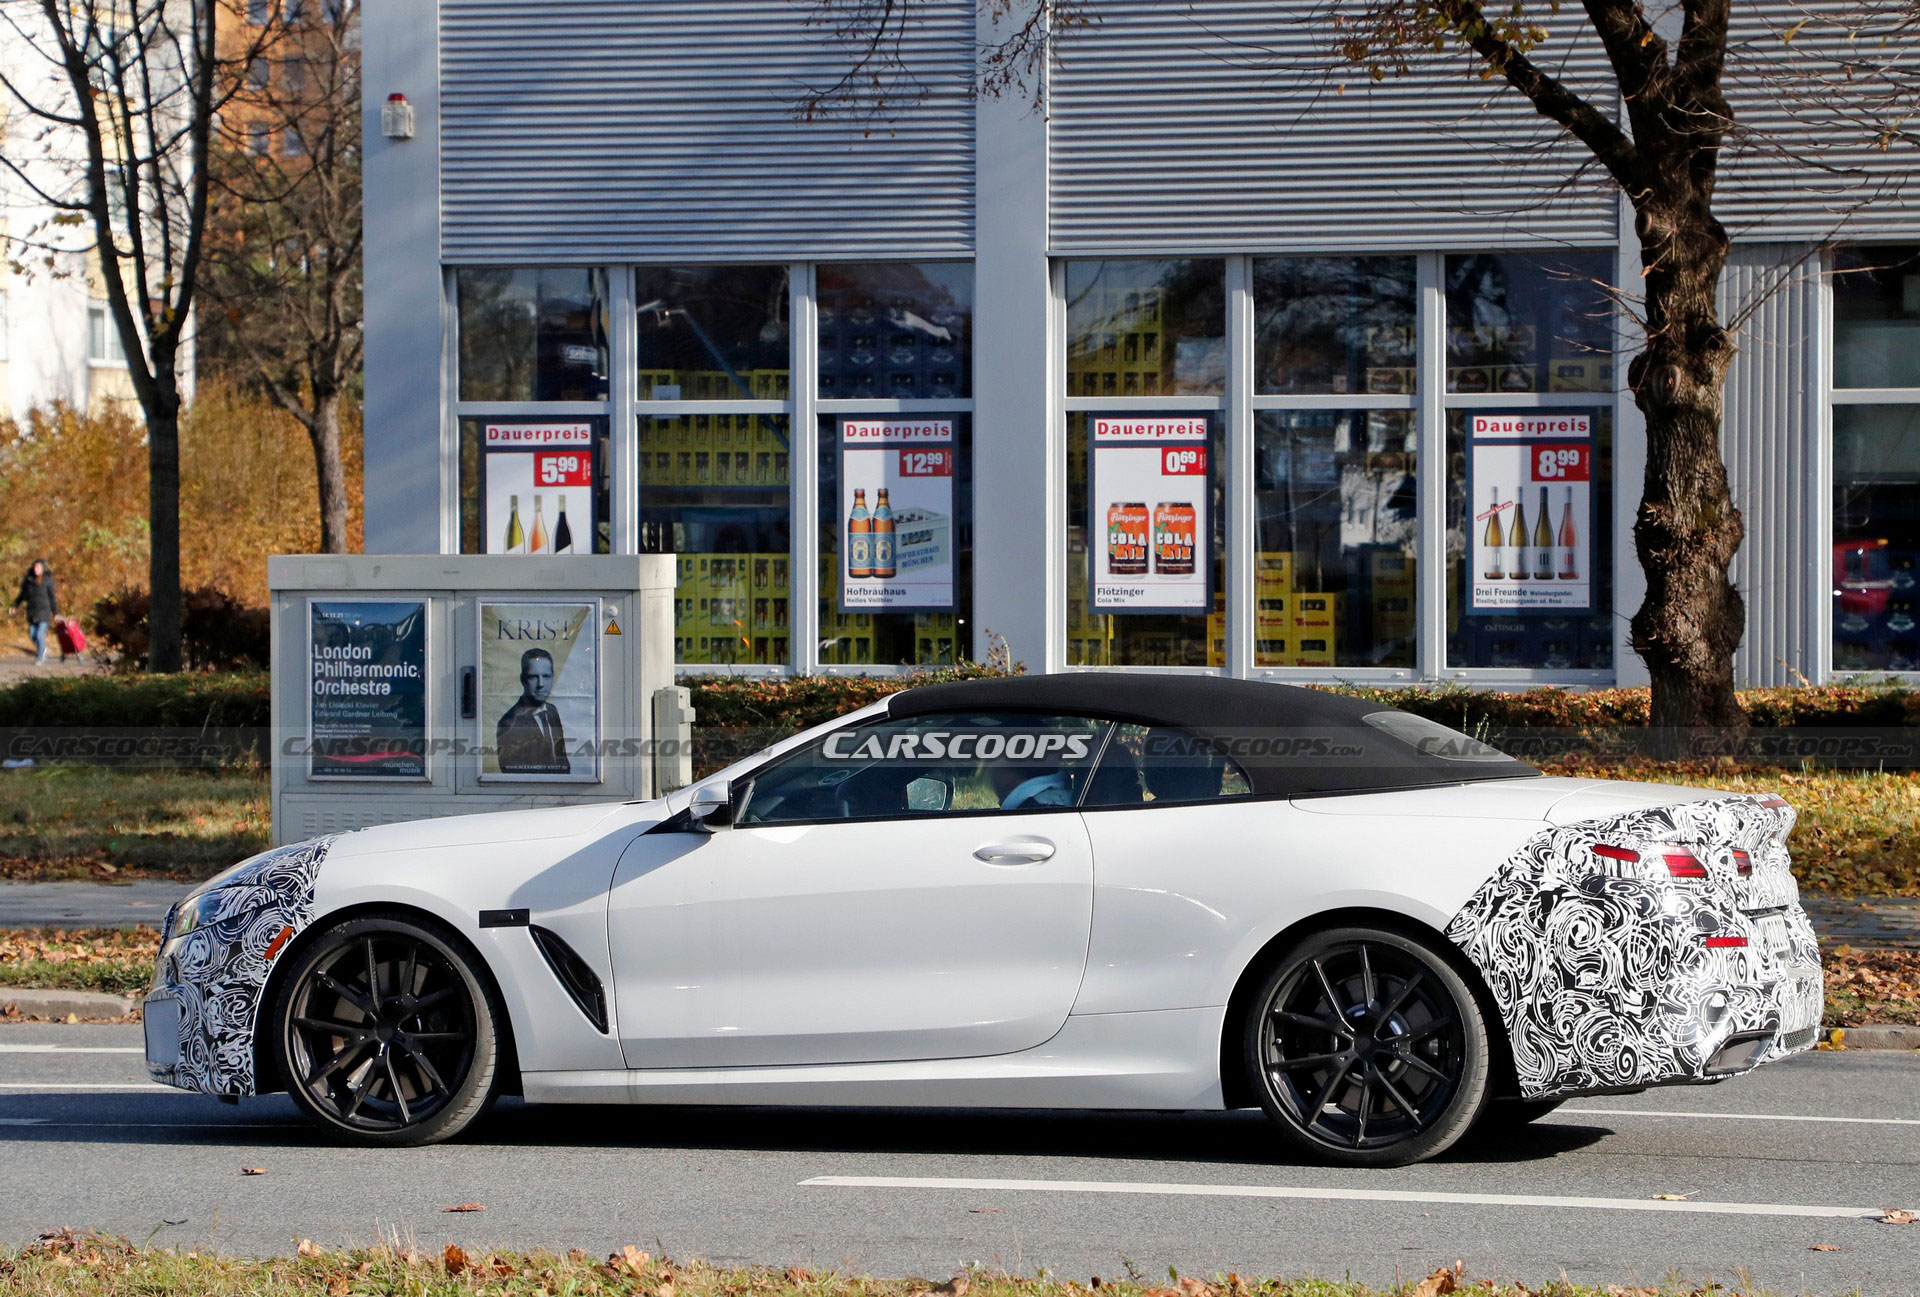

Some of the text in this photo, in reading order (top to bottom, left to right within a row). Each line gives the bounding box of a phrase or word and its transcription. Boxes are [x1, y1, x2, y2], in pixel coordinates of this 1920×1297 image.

[488, 426, 589, 442] Dauerpreis
[846, 423, 950, 440] Dauerpreis
[1097, 421, 1205, 437] Dauerpreis
[1476, 418, 1588, 435] Dauerpreis
[541, 456, 579, 483] 5.99
[903, 452, 944, 474] 12.99
[1166, 451, 1197, 472] 0.69
[1538, 449, 1580, 477] 8.99
[1110, 533, 1147, 547] COLA
[1156, 533, 1194, 547] COLA
[1114, 547, 1145, 560] MIX
[1161, 547, 1192, 560] MIX
[846, 587, 907, 596] Hofbräuhaus
[1097, 587, 1145, 597] Flötzinger
[1475, 588, 1493, 596] Drei
[1494, 588, 1528, 596] Freunde
[496, 619, 577, 641] KRIST
[314, 643, 372, 660] London
[314, 661, 418, 678] Philharmonic
[314, 679, 391, 695] Orchestra
[371, 711, 398, 719] Leitung
